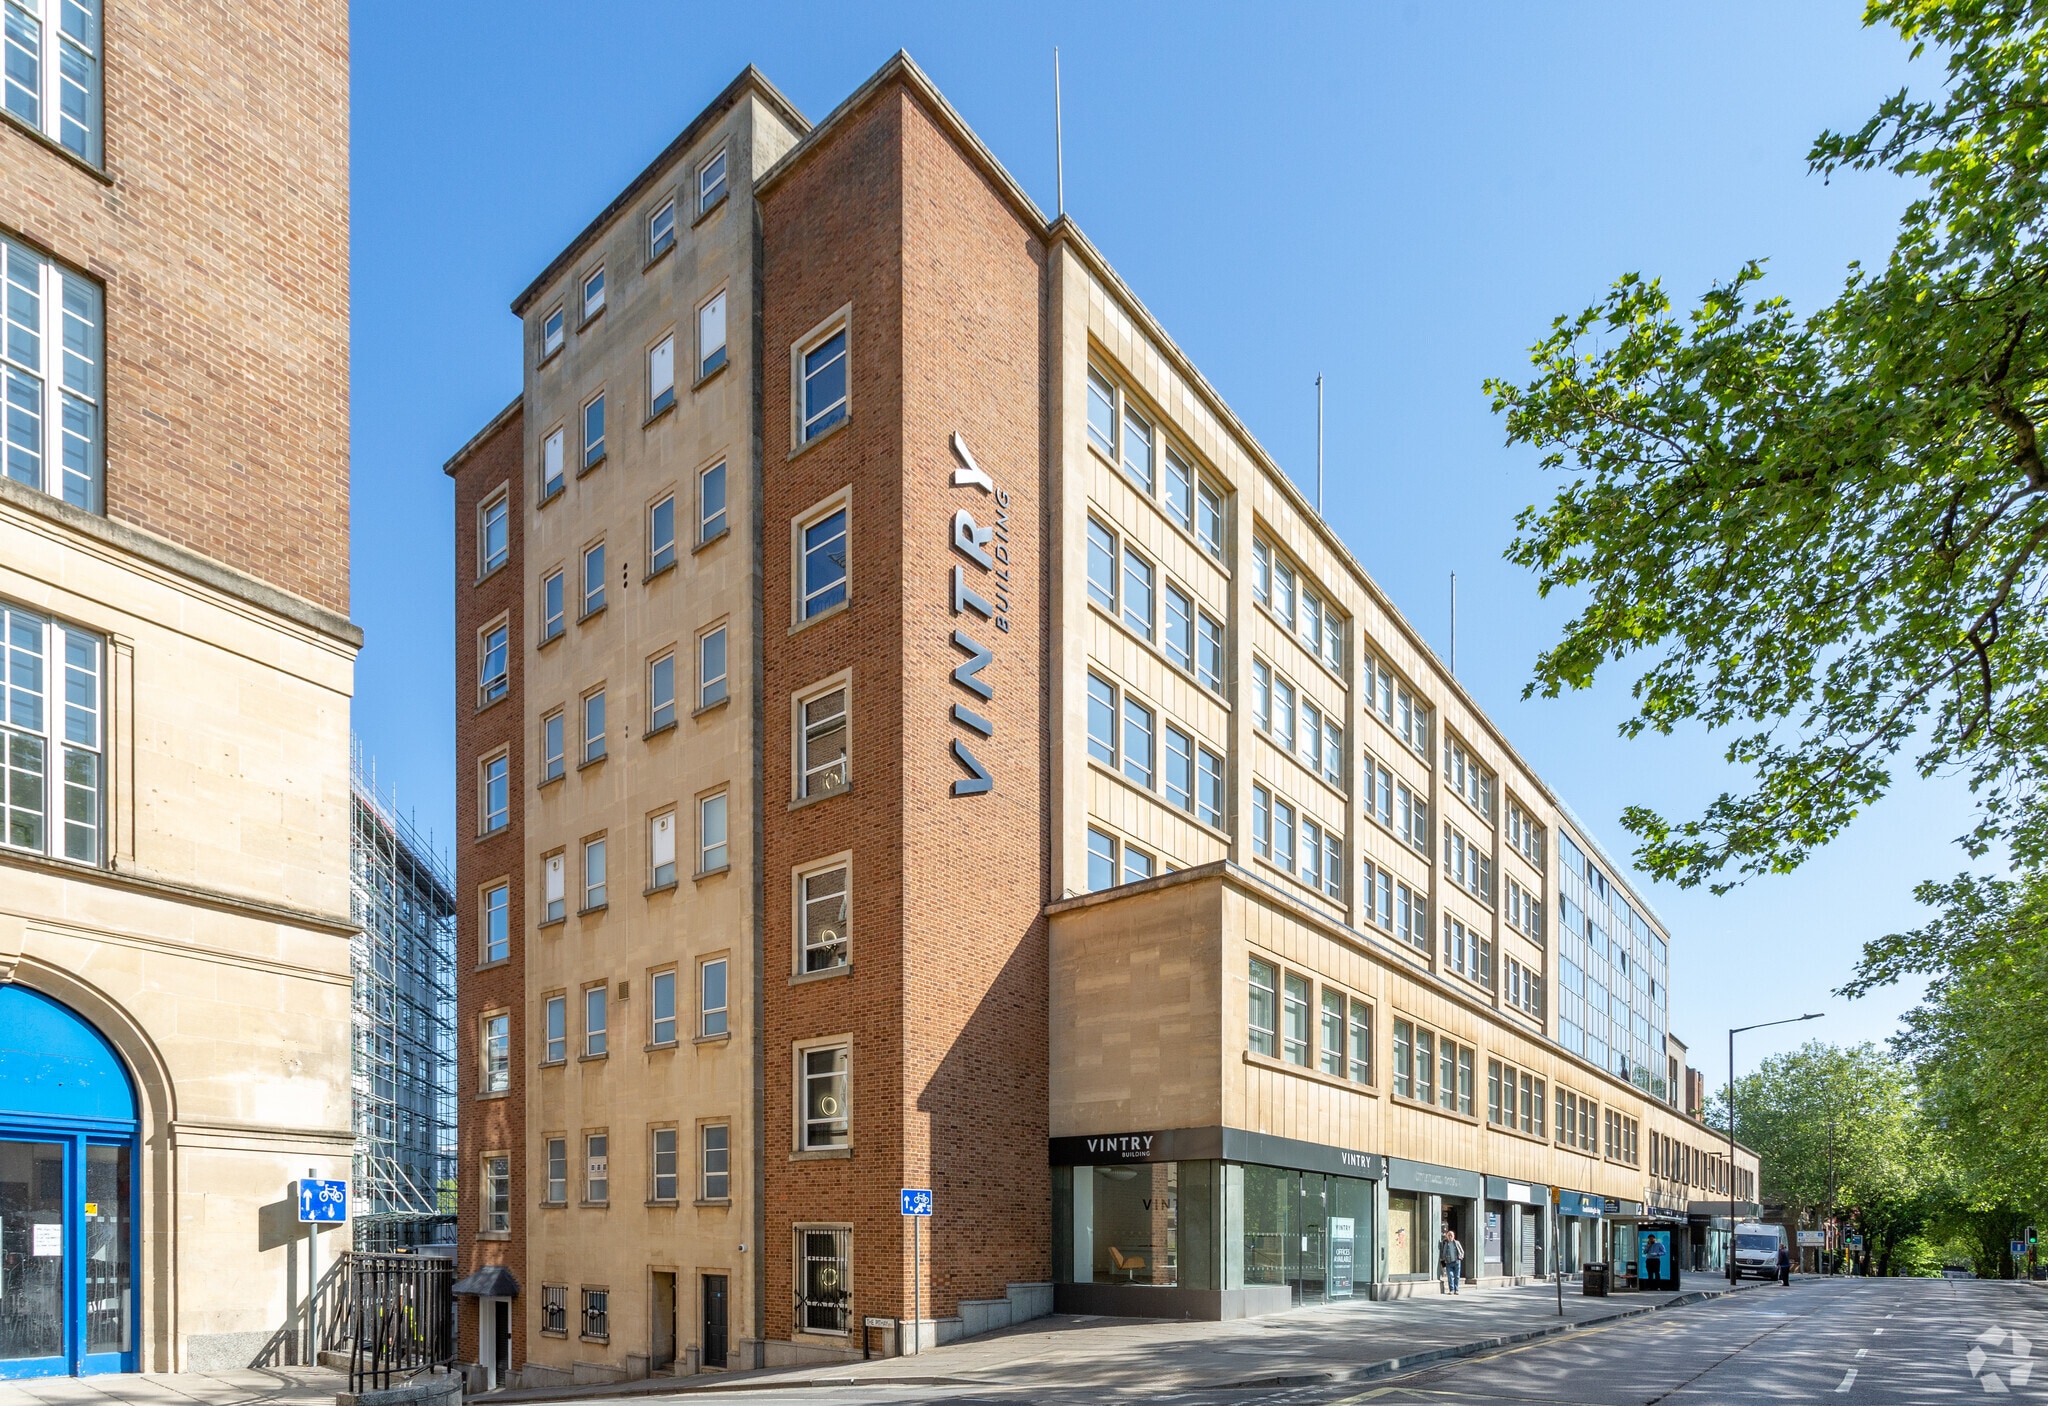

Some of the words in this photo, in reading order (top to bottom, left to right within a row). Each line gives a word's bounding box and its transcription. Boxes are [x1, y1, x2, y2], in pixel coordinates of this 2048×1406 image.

[996, 487, 1010, 634] BUILDING
[954, 430, 993, 795] VINTRY
[1087, 1135, 1154, 1153] VINTRY
[1121, 1150, 1151, 1158] BUILDING
[1341, 1151, 1371, 1168] VINTRY
